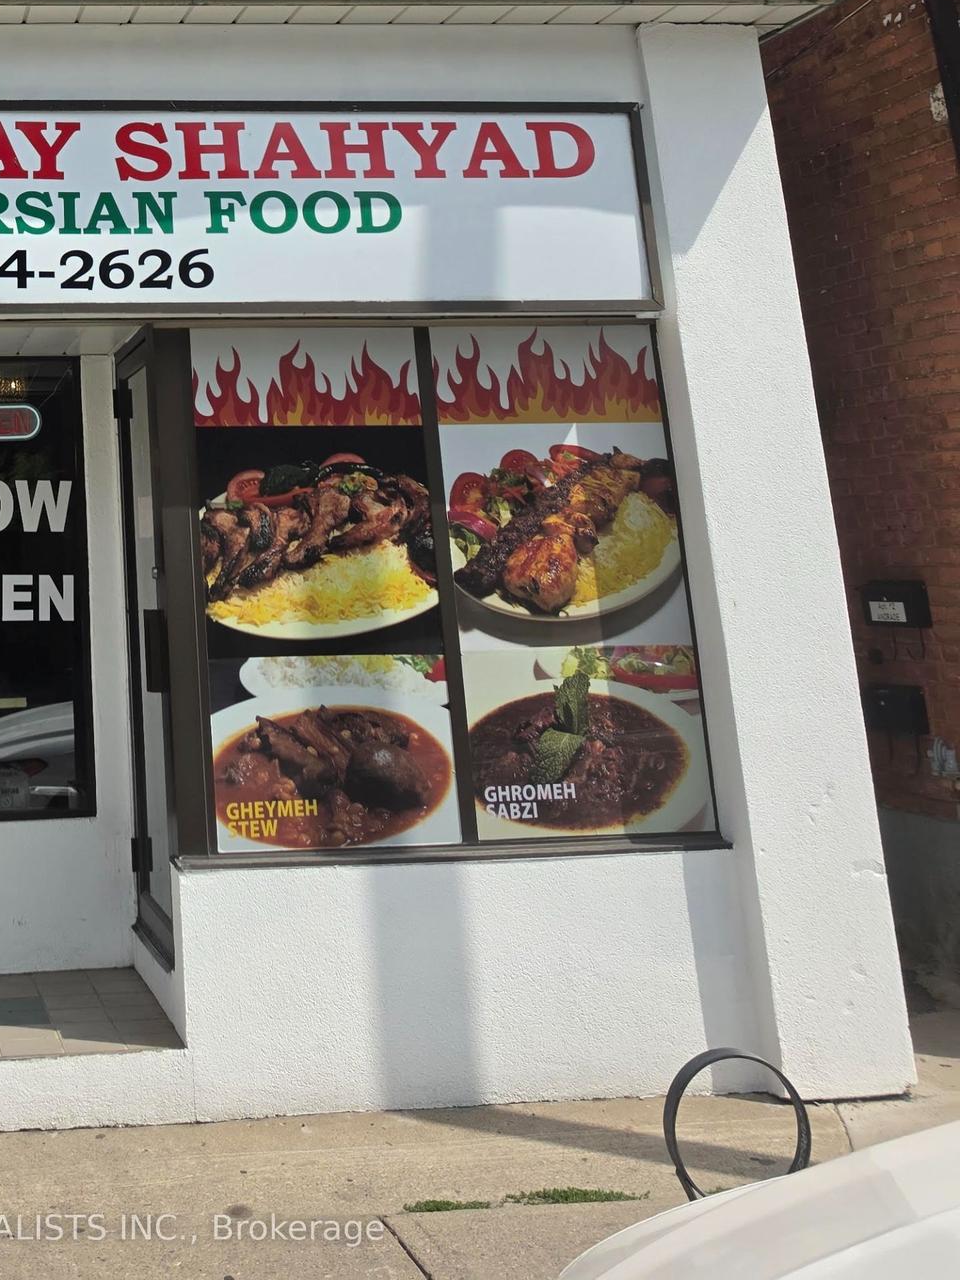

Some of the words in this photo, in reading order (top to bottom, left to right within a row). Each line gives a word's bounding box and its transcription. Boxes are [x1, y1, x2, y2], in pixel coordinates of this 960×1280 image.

[114, 120, 596, 182] SHAHYAD
[204, 189, 403, 235] FOOD
[484, 782, 577, 803] GHROMEH
[226, 798, 319, 821] GHEYMEH
[486, 801, 539, 820] SABZI
[227, 819, 278, 838] STEW
